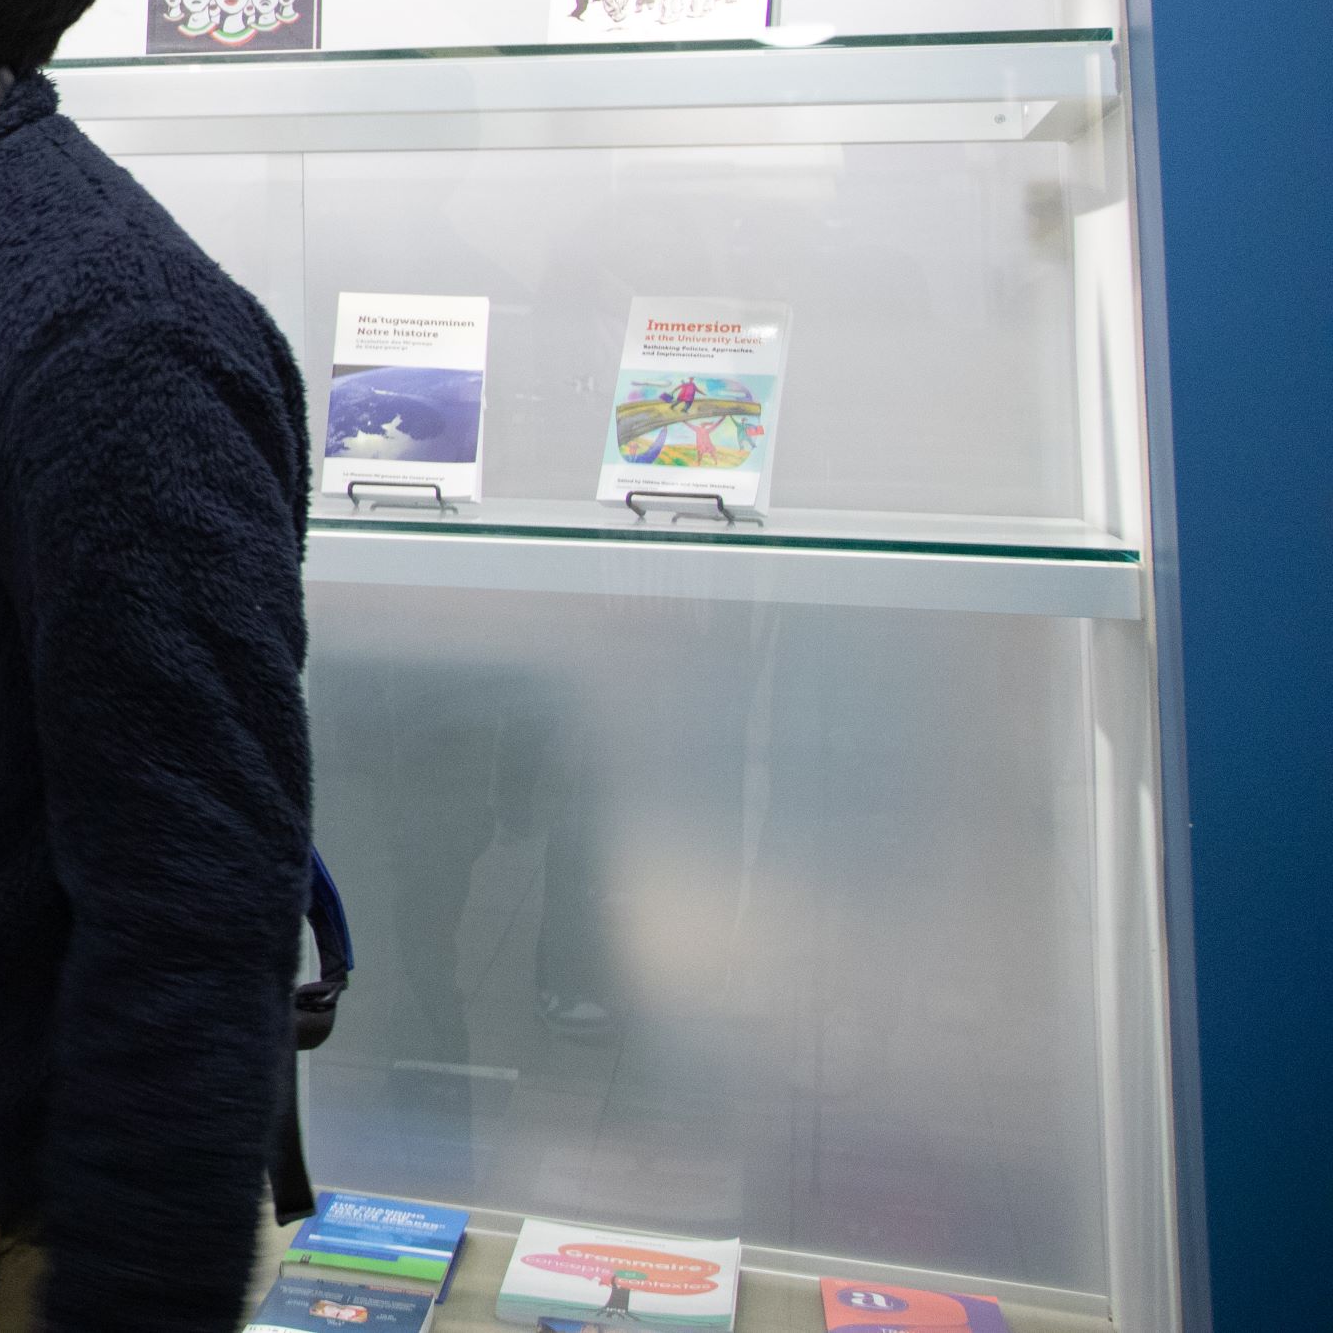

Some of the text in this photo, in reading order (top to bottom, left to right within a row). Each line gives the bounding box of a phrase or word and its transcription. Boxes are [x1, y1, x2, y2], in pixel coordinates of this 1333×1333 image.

[357, 327, 439, 338] Notre histoire
[646, 319, 742, 333] Immersion
[658, 334, 674, 342] the
[678, 334, 731, 345] University
[734, 337, 762, 346] Level
[643, 344, 680, 352] Rethinking
[525, 1256, 611, 1274] concepts
[565, 1247, 702, 1273] Grammaire
[617, 1277, 711, 1290] contextes
